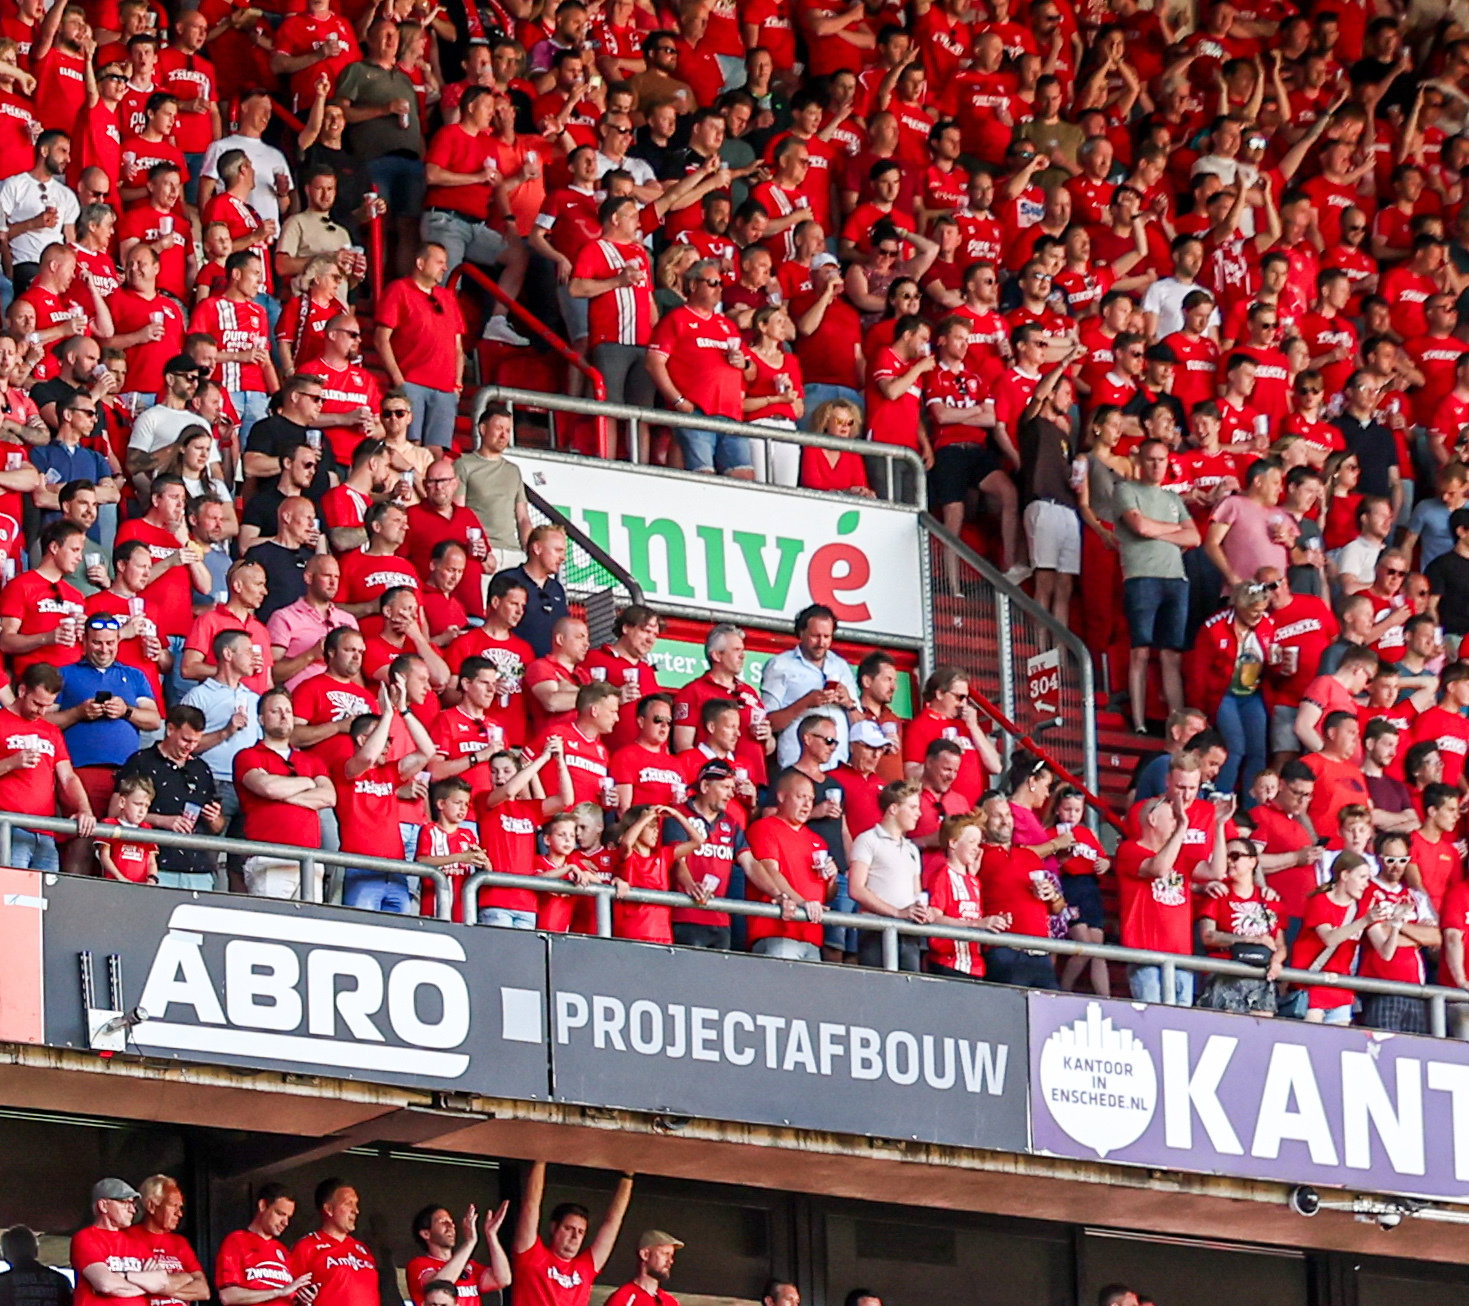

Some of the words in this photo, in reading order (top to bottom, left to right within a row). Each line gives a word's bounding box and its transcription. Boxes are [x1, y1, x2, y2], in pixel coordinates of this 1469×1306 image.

[1030, 673, 1058, 698] 304
[139, 931, 471, 1050] ABRO
[556, 990, 1009, 1097] PROJECTAFBOUW
[1062, 1055, 1135, 1079] KANTOOR
[1090, 1075, 1108, 1090] IN
[1050, 1087, 1150, 1113] ENSCHEDE.NL
